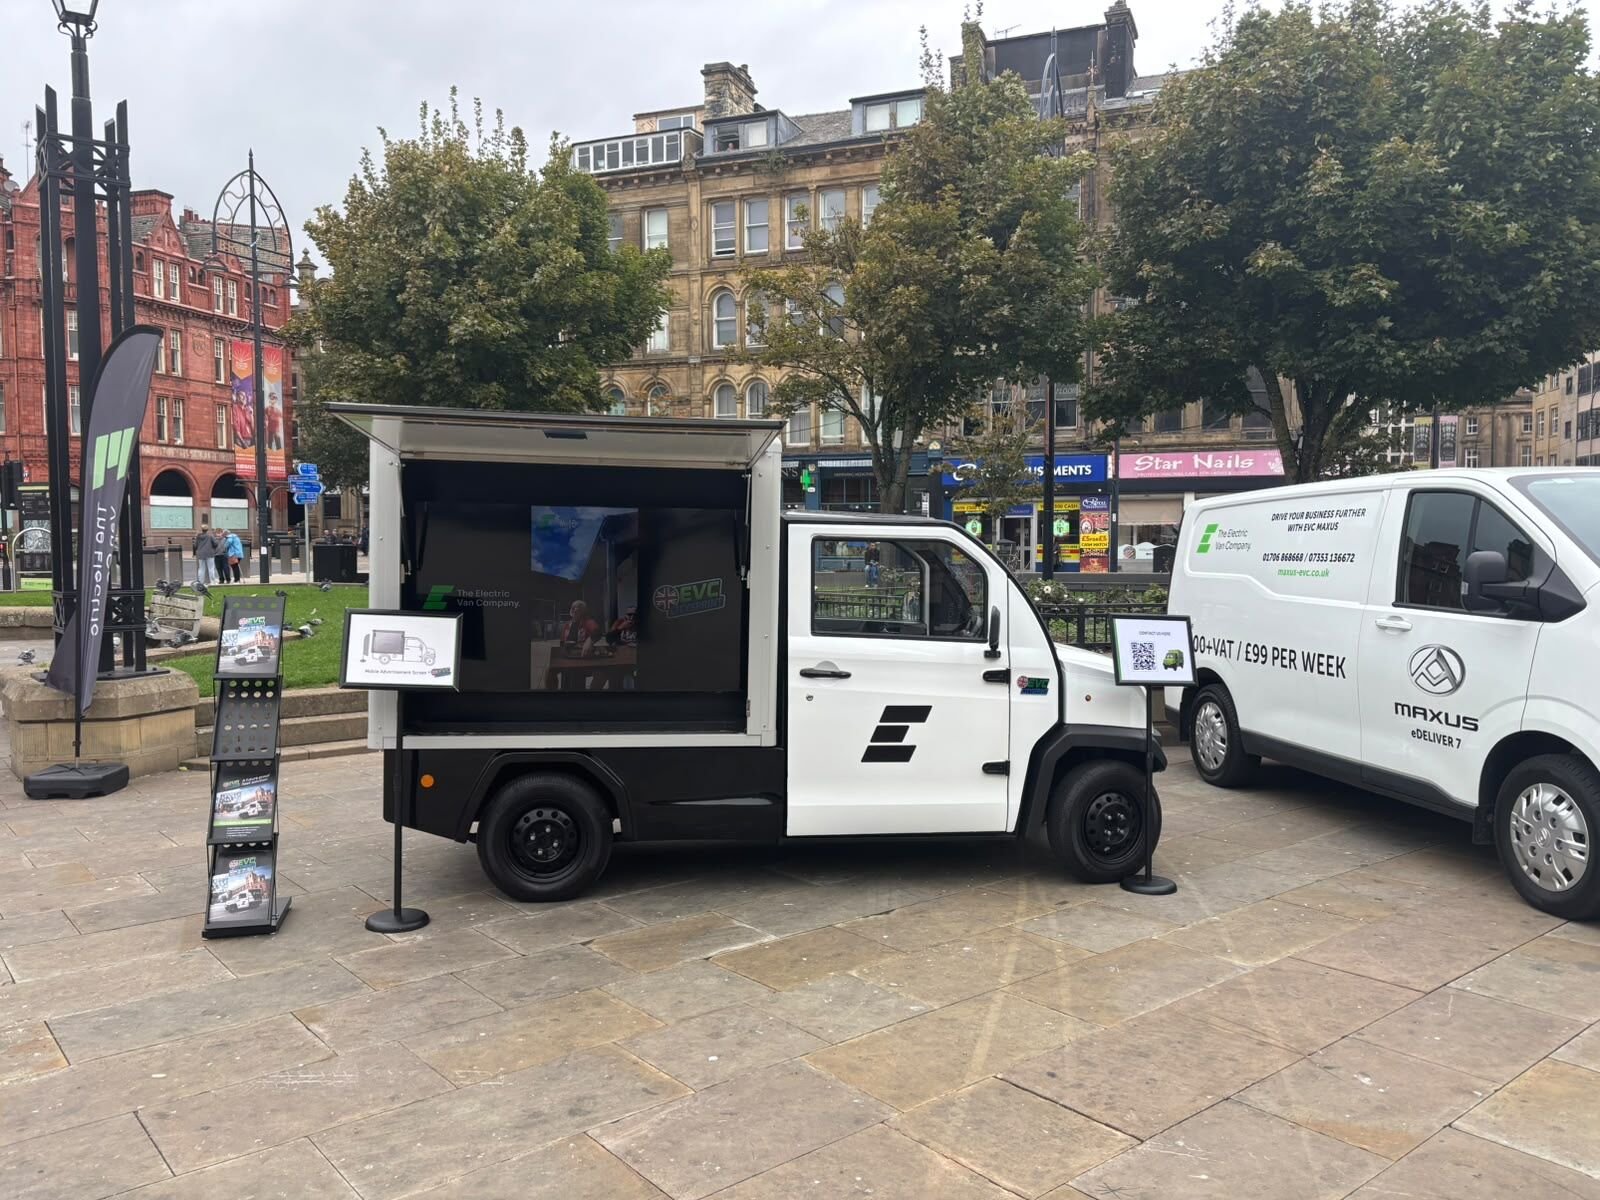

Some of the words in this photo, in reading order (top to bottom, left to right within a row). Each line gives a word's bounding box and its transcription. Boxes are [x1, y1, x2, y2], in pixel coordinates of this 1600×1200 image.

[1133, 455, 1182, 471] Star
[1193, 454, 1254, 469] Nails
[1271, 513, 1288, 521] DRIVE
[1288, 511, 1305, 520] YOUR
[1305, 510, 1334, 519] BUSINESS
[1335, 508, 1366, 518] FURTHER
[1287, 523, 1303, 532] WITH
[1303, 523, 1316, 531] EVC
[1316, 522, 1339, 531] MAXUS
[1329, 553, 1355, 563] 136672
[1278, 568, 1330, 577] maxus-evc.co.uk
[457, 589, 474, 598] The
[475, 589, 510, 598] Electric
[680, 581, 720, 602] EVC
[457, 599, 474, 607] Van
[1245, 642, 1268, 665] £99
[1272, 646, 1297, 671] PER
[1301, 651, 1346, 679] WEEK
[1394, 702, 1479, 732] MAXUS
[1411, 728, 1454, 748] eDELIVER
[1455, 738, 1461, 749] 7
